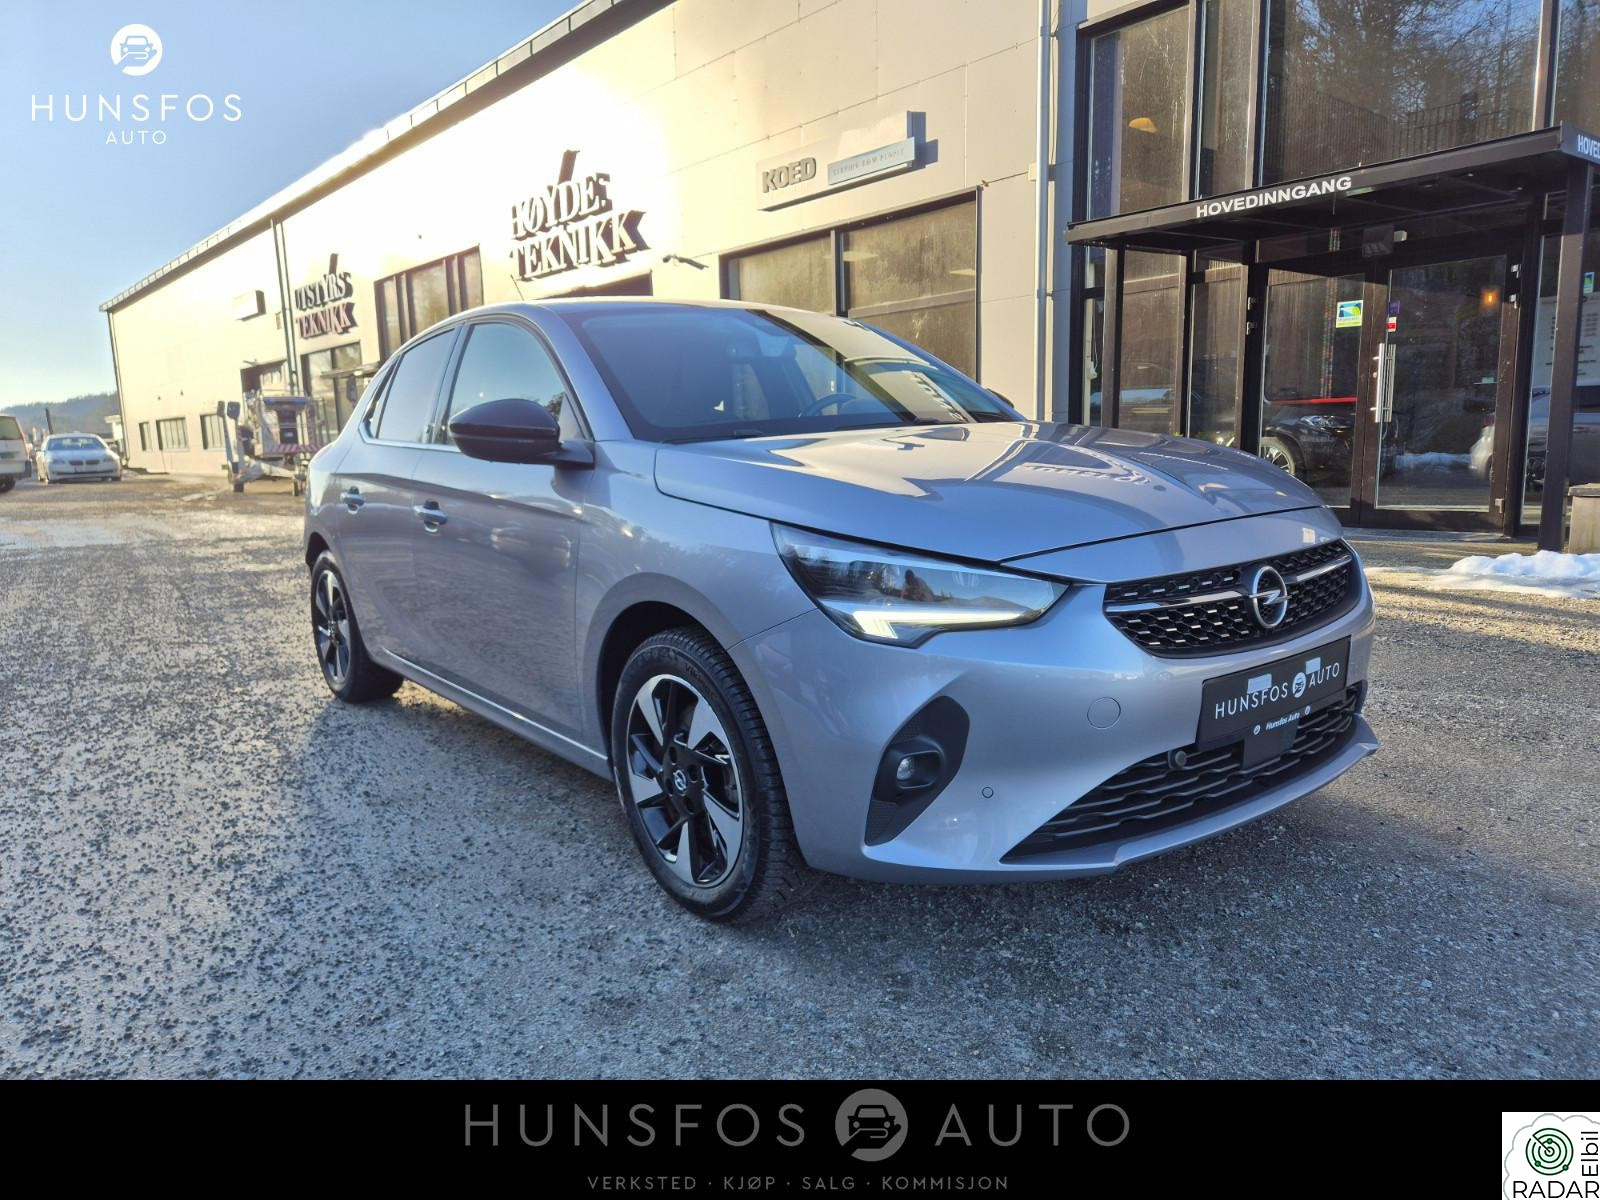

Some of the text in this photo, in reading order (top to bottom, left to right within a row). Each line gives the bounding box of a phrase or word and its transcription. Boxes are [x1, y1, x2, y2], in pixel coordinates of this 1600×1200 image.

[761, 156, 817, 194] KOED
[1196, 176, 1352, 218] HOVEDINNGANG
[510, 208, 646, 281] TEKNIKK
[1215, 662, 1341, 719] HUNSFOS AUTO
